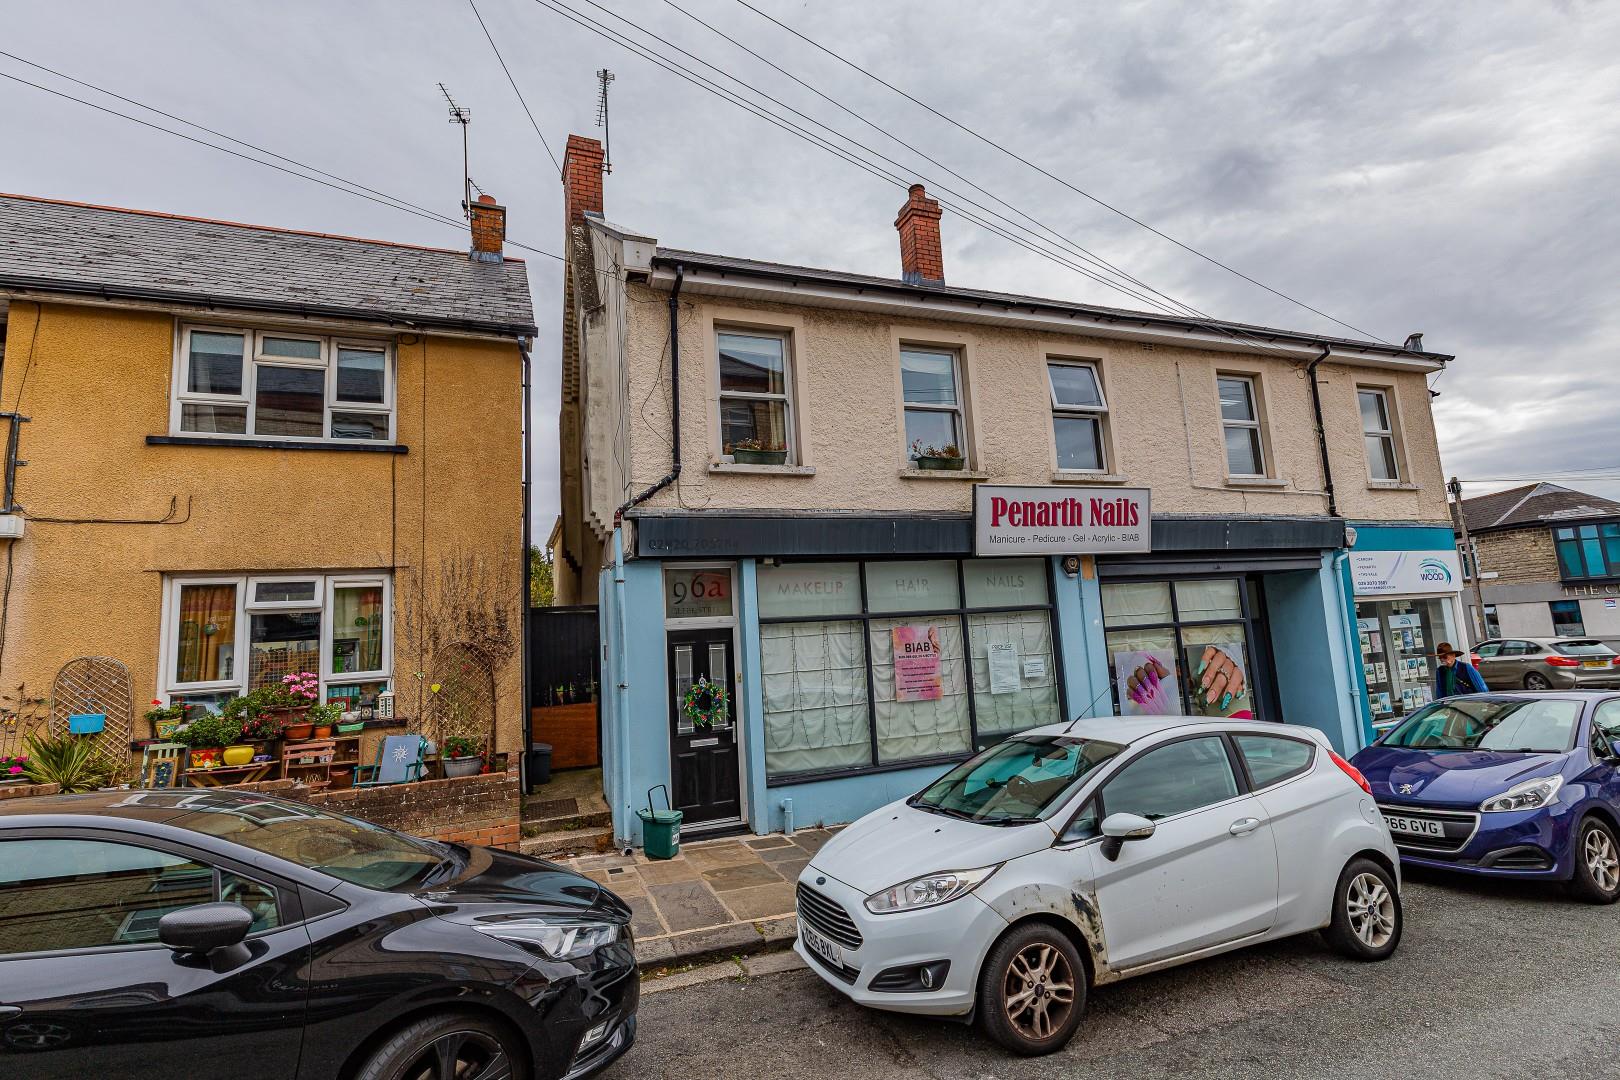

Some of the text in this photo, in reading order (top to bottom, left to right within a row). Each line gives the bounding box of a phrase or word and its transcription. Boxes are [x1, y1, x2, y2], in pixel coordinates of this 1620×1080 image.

[990, 496, 1139, 527] Penarth Nails
[989, 534, 1026, 544] Manicure
[1032, 534, 1066, 543] Pedicure
[1072, 534, 1086, 543] Gel
[1091, 533, 1116, 544] Acrylic
[1122, 533, 1140, 542] BIAB
[986, 575, 1025, 589] NAILS
[1420, 573, 1444, 581] WOOD
[673, 574, 724, 605] 96a
[777, 581, 844, 595] MAKEUP
[895, 578, 931, 593] HAIR
[1562, 584, 1600, 596] THE
[904, 642, 931, 653] BIAB
[1410, 820, 1438, 834] GVG
